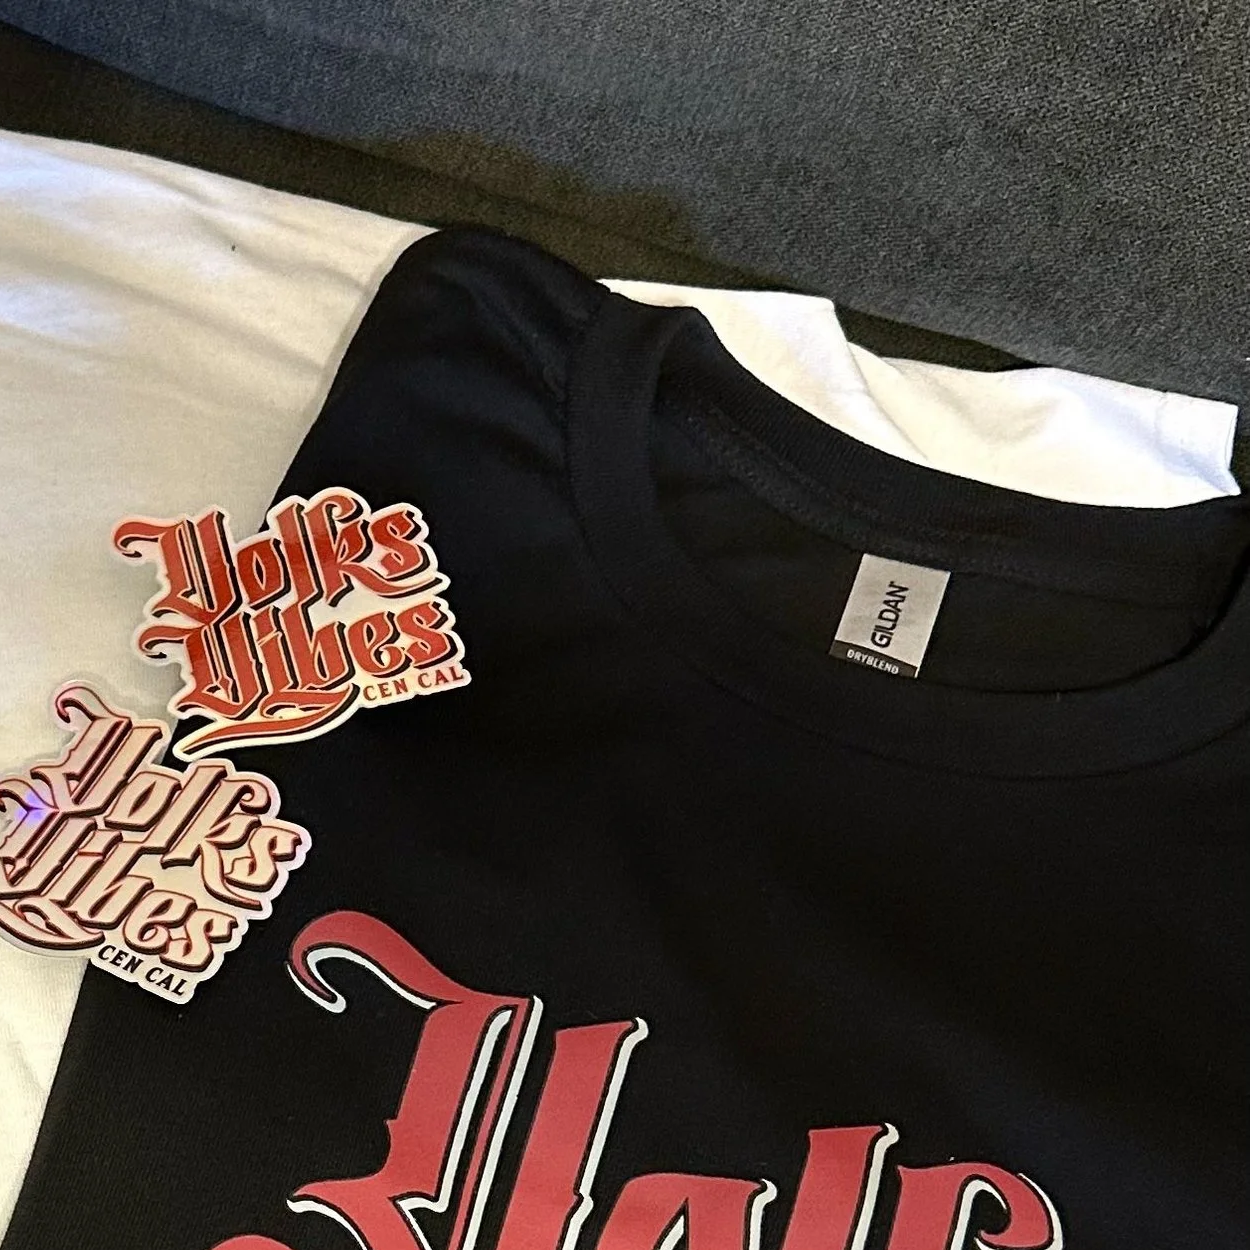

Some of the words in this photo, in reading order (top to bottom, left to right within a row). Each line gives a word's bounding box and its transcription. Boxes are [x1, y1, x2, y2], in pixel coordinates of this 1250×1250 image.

[871, 581, 909, 648] GILDAN
[847, 649, 899, 675] DRYBLEND
[362, 679, 408, 702] CEN
[419, 666, 464, 688] CAL
[98, 945, 148, 974] CEN
[145, 967, 187, 996] CAL
